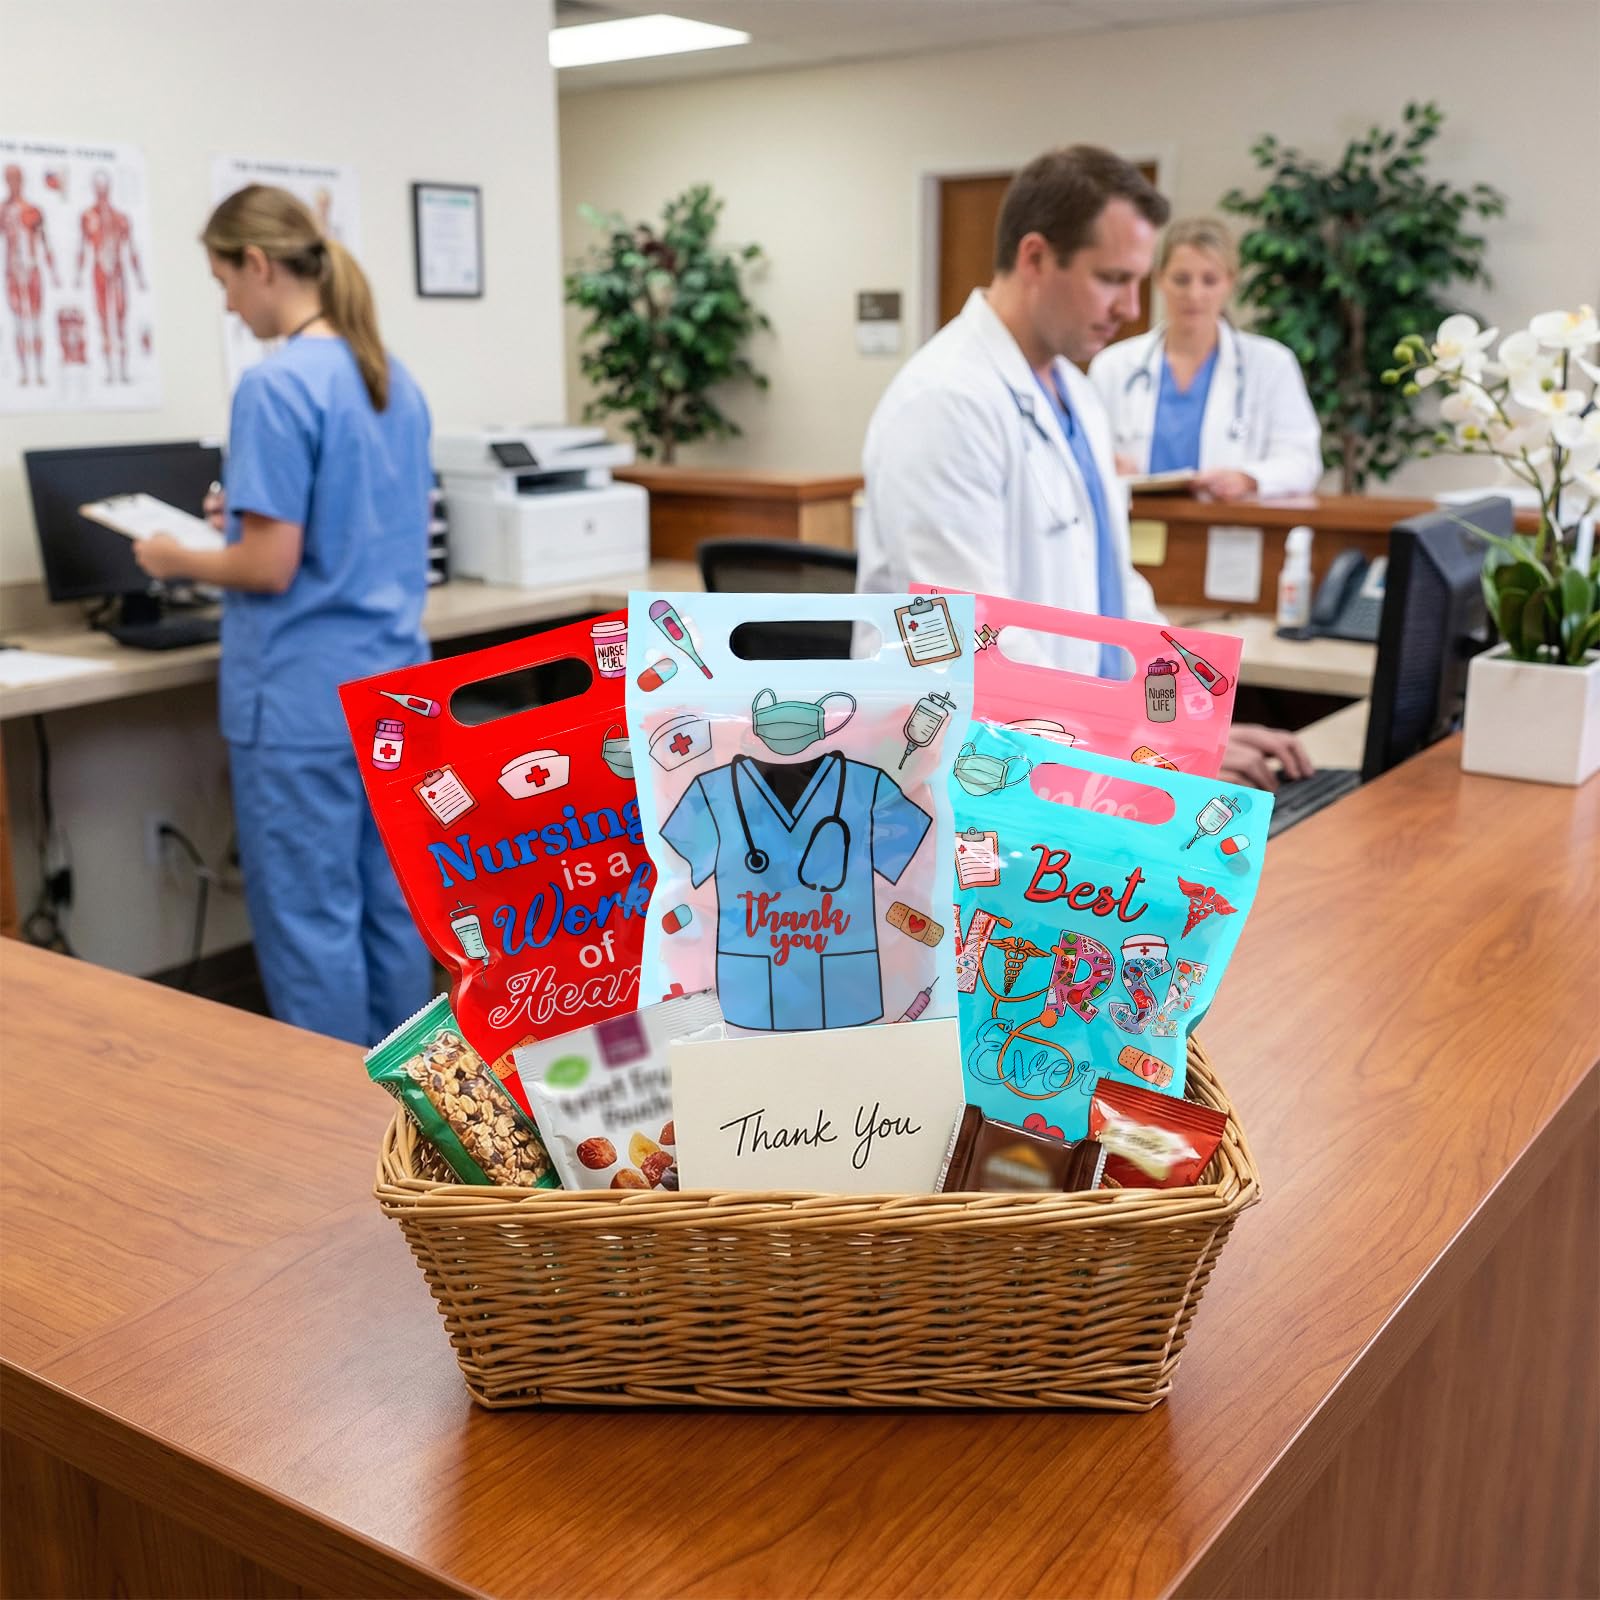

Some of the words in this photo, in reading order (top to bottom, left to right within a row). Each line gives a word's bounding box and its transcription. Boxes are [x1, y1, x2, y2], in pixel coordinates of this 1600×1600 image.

[597, 644, 625, 658] NURSE
[602, 656, 623, 668] FUEL
[1152, 699, 1170, 711] LIFE
[427, 797, 645, 888] Nursing
[561, 859, 597, 891] is
[607, 850, 632, 878] a
[1023, 843, 1149, 923] Best
[492, 861, 651, 956] Work
[578, 929, 615, 969] of
[769, 933, 829, 966] you
[488, 964, 643, 1030] Hear
[967, 1017, 1109, 1096] Ever
[719, 1108, 838, 1157] Thank
[851, 1102, 922, 1169] You
